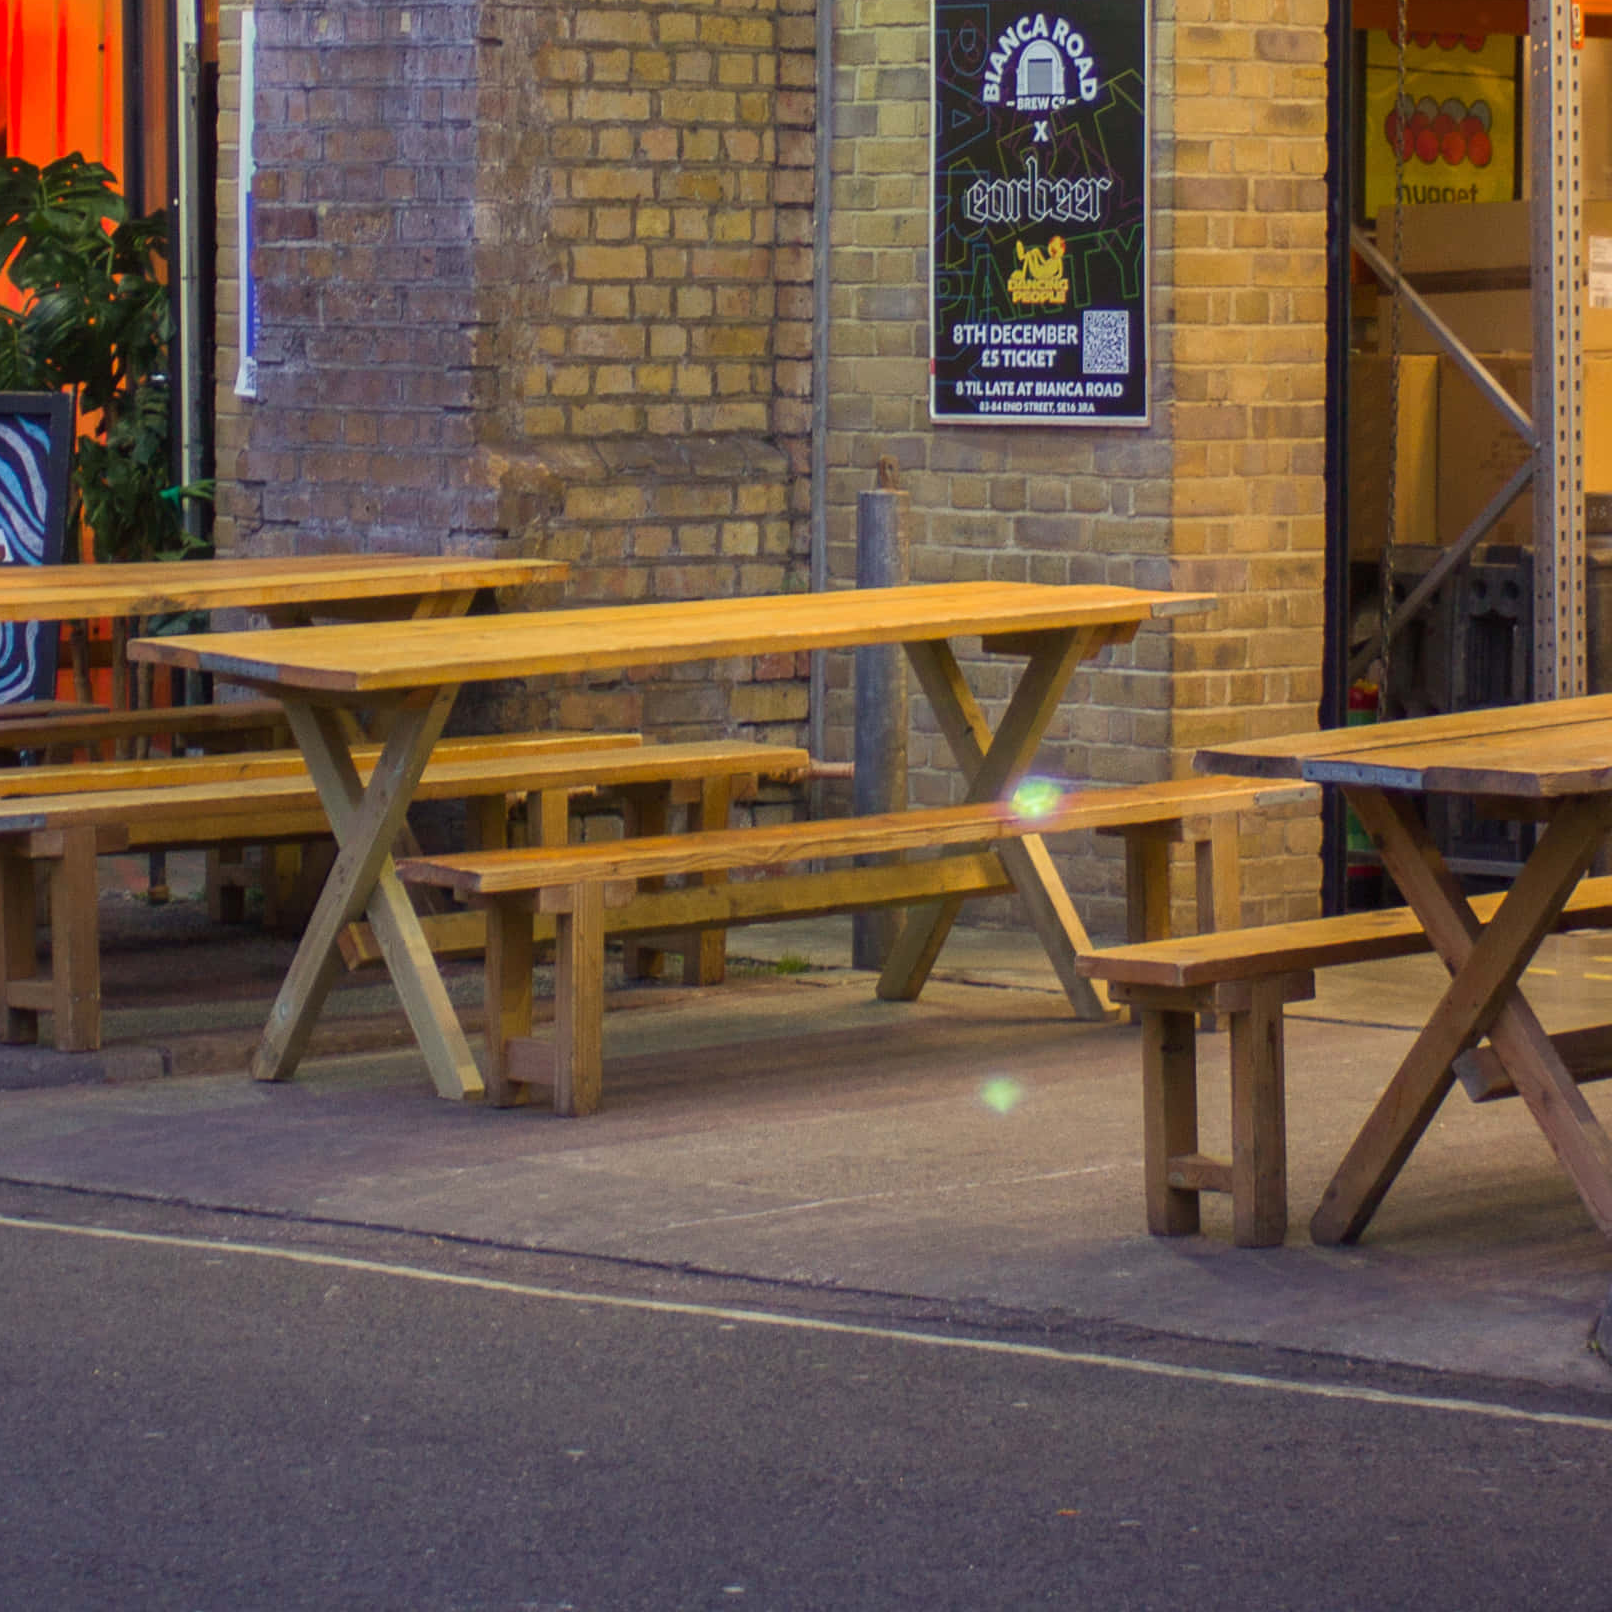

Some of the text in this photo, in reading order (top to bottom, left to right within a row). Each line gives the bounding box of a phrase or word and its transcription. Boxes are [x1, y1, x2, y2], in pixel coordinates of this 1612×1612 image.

[982, 12, 1098, 104] BIANCA ROAD
[1016, 96, 1050, 111] BREW
[1033, 120, 1049, 143] X
[965, 155, 1112, 222] earbeer
[1006, 277, 1070, 293] DANCING
[1011, 290, 1067, 305] PEOPLE
[952, 323, 1079, 346] 8TH DECEMBER
[980, 349, 1057, 368] £5 TICKET
[955, 381, 1124, 398] 8 TIL LATE AT BIANCA ROAD
